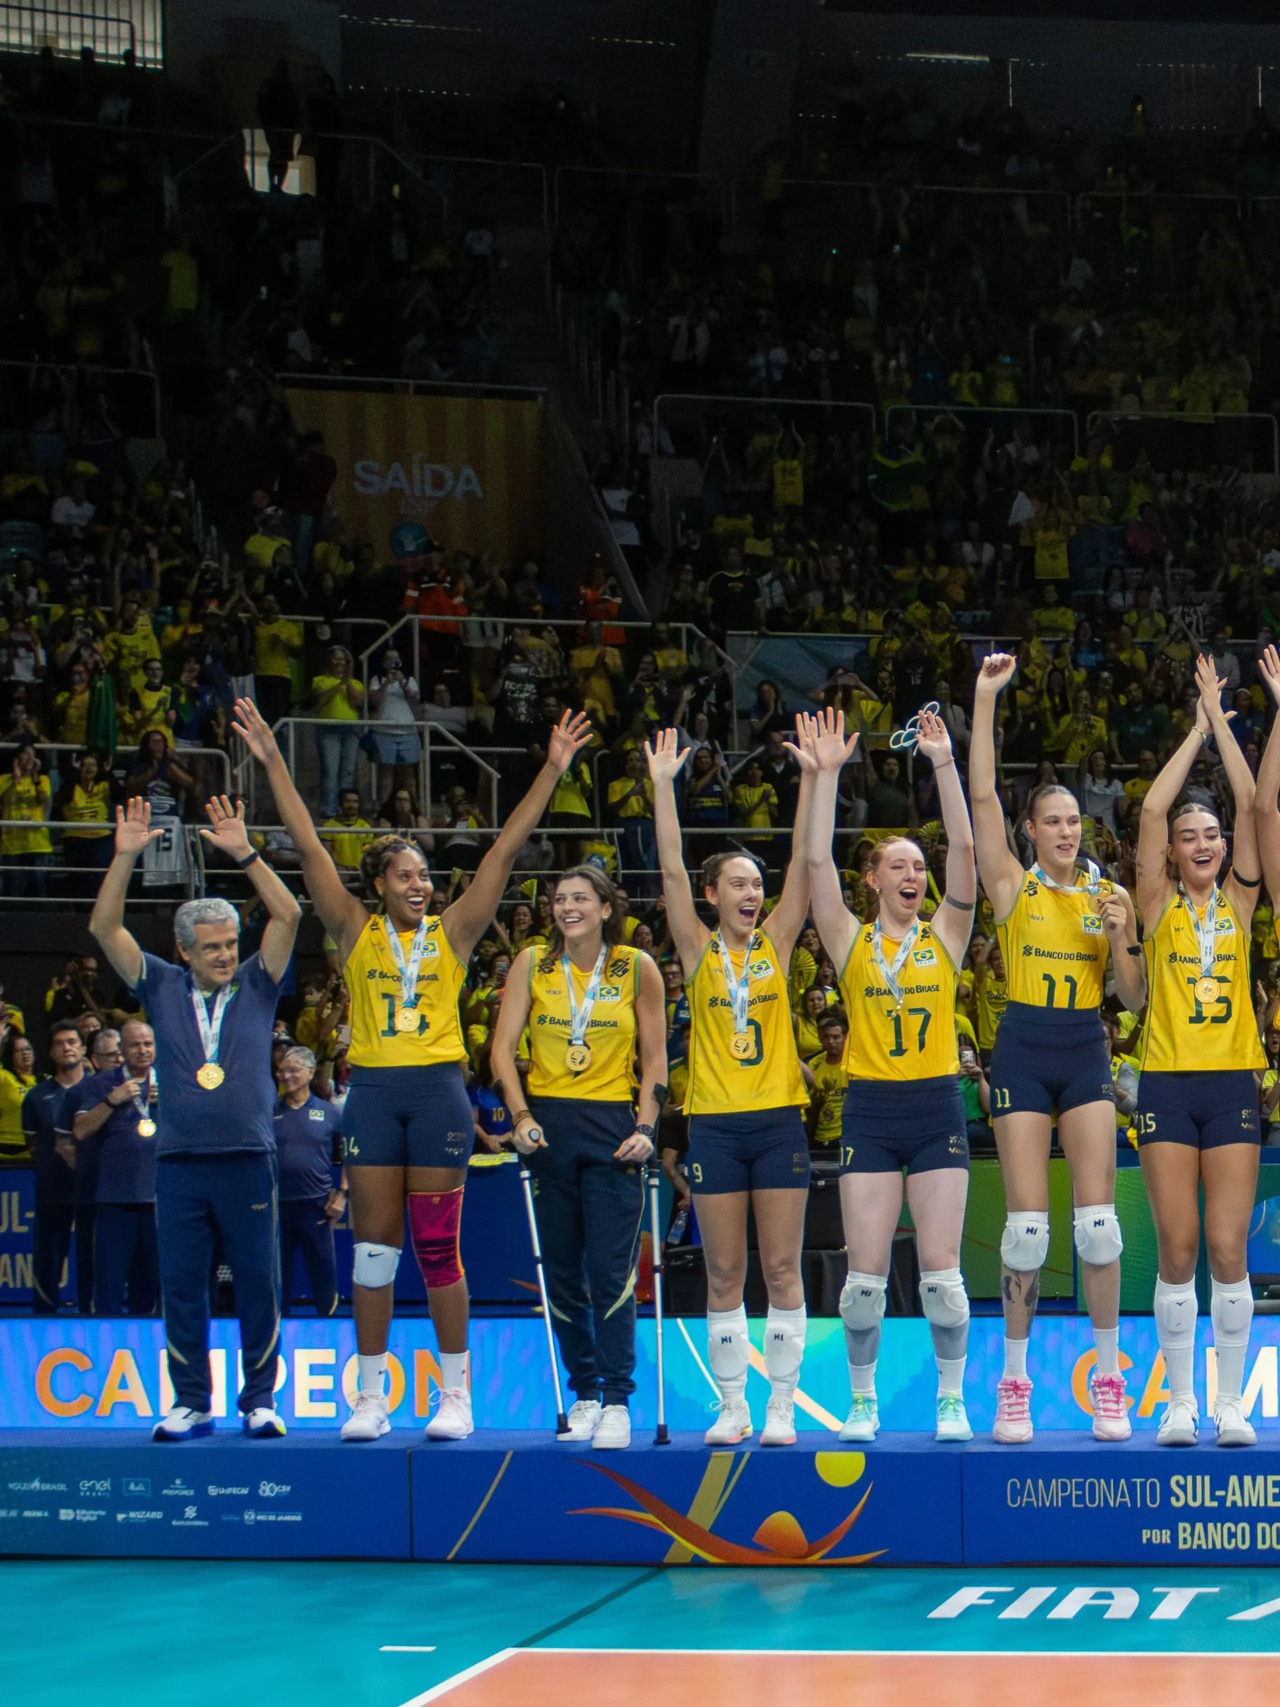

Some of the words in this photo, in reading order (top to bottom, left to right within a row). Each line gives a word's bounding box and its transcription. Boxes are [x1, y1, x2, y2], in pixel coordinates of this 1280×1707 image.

[353, 451, 485, 499] SAÍDA
[1034, 948, 1063, 960] BANCO
[1064, 952, 1075, 961] DO
[1076, 951, 1099, 962] BRASIL
[876, 988, 893, 996] BAN
[904, 987, 915, 995] DO
[915, 984, 940, 993] BRASIL
[1042, 973, 1077, 1010] 11
[1187, 976, 1232, 1024] 15
[549, 1016, 572, 1026] BANC
[590, 1019, 618, 1028] BRASIL
[886, 1007, 932, 1057] 17
[995, 1088, 1011, 1108] 11
[1140, 1113, 1156, 1134] 15
[692, 1163, 703, 1182] 9
[79, 1478, 111, 1491] enel
[1006, 1477, 1160, 1508] CAMPEONATO
[129, 1511, 163, 1519] WIZARD
[1142, 1528, 1171, 1545] POR
[1178, 1522, 1250, 1550] BANCO
[926, 1587, 1220, 1619] FIAT
